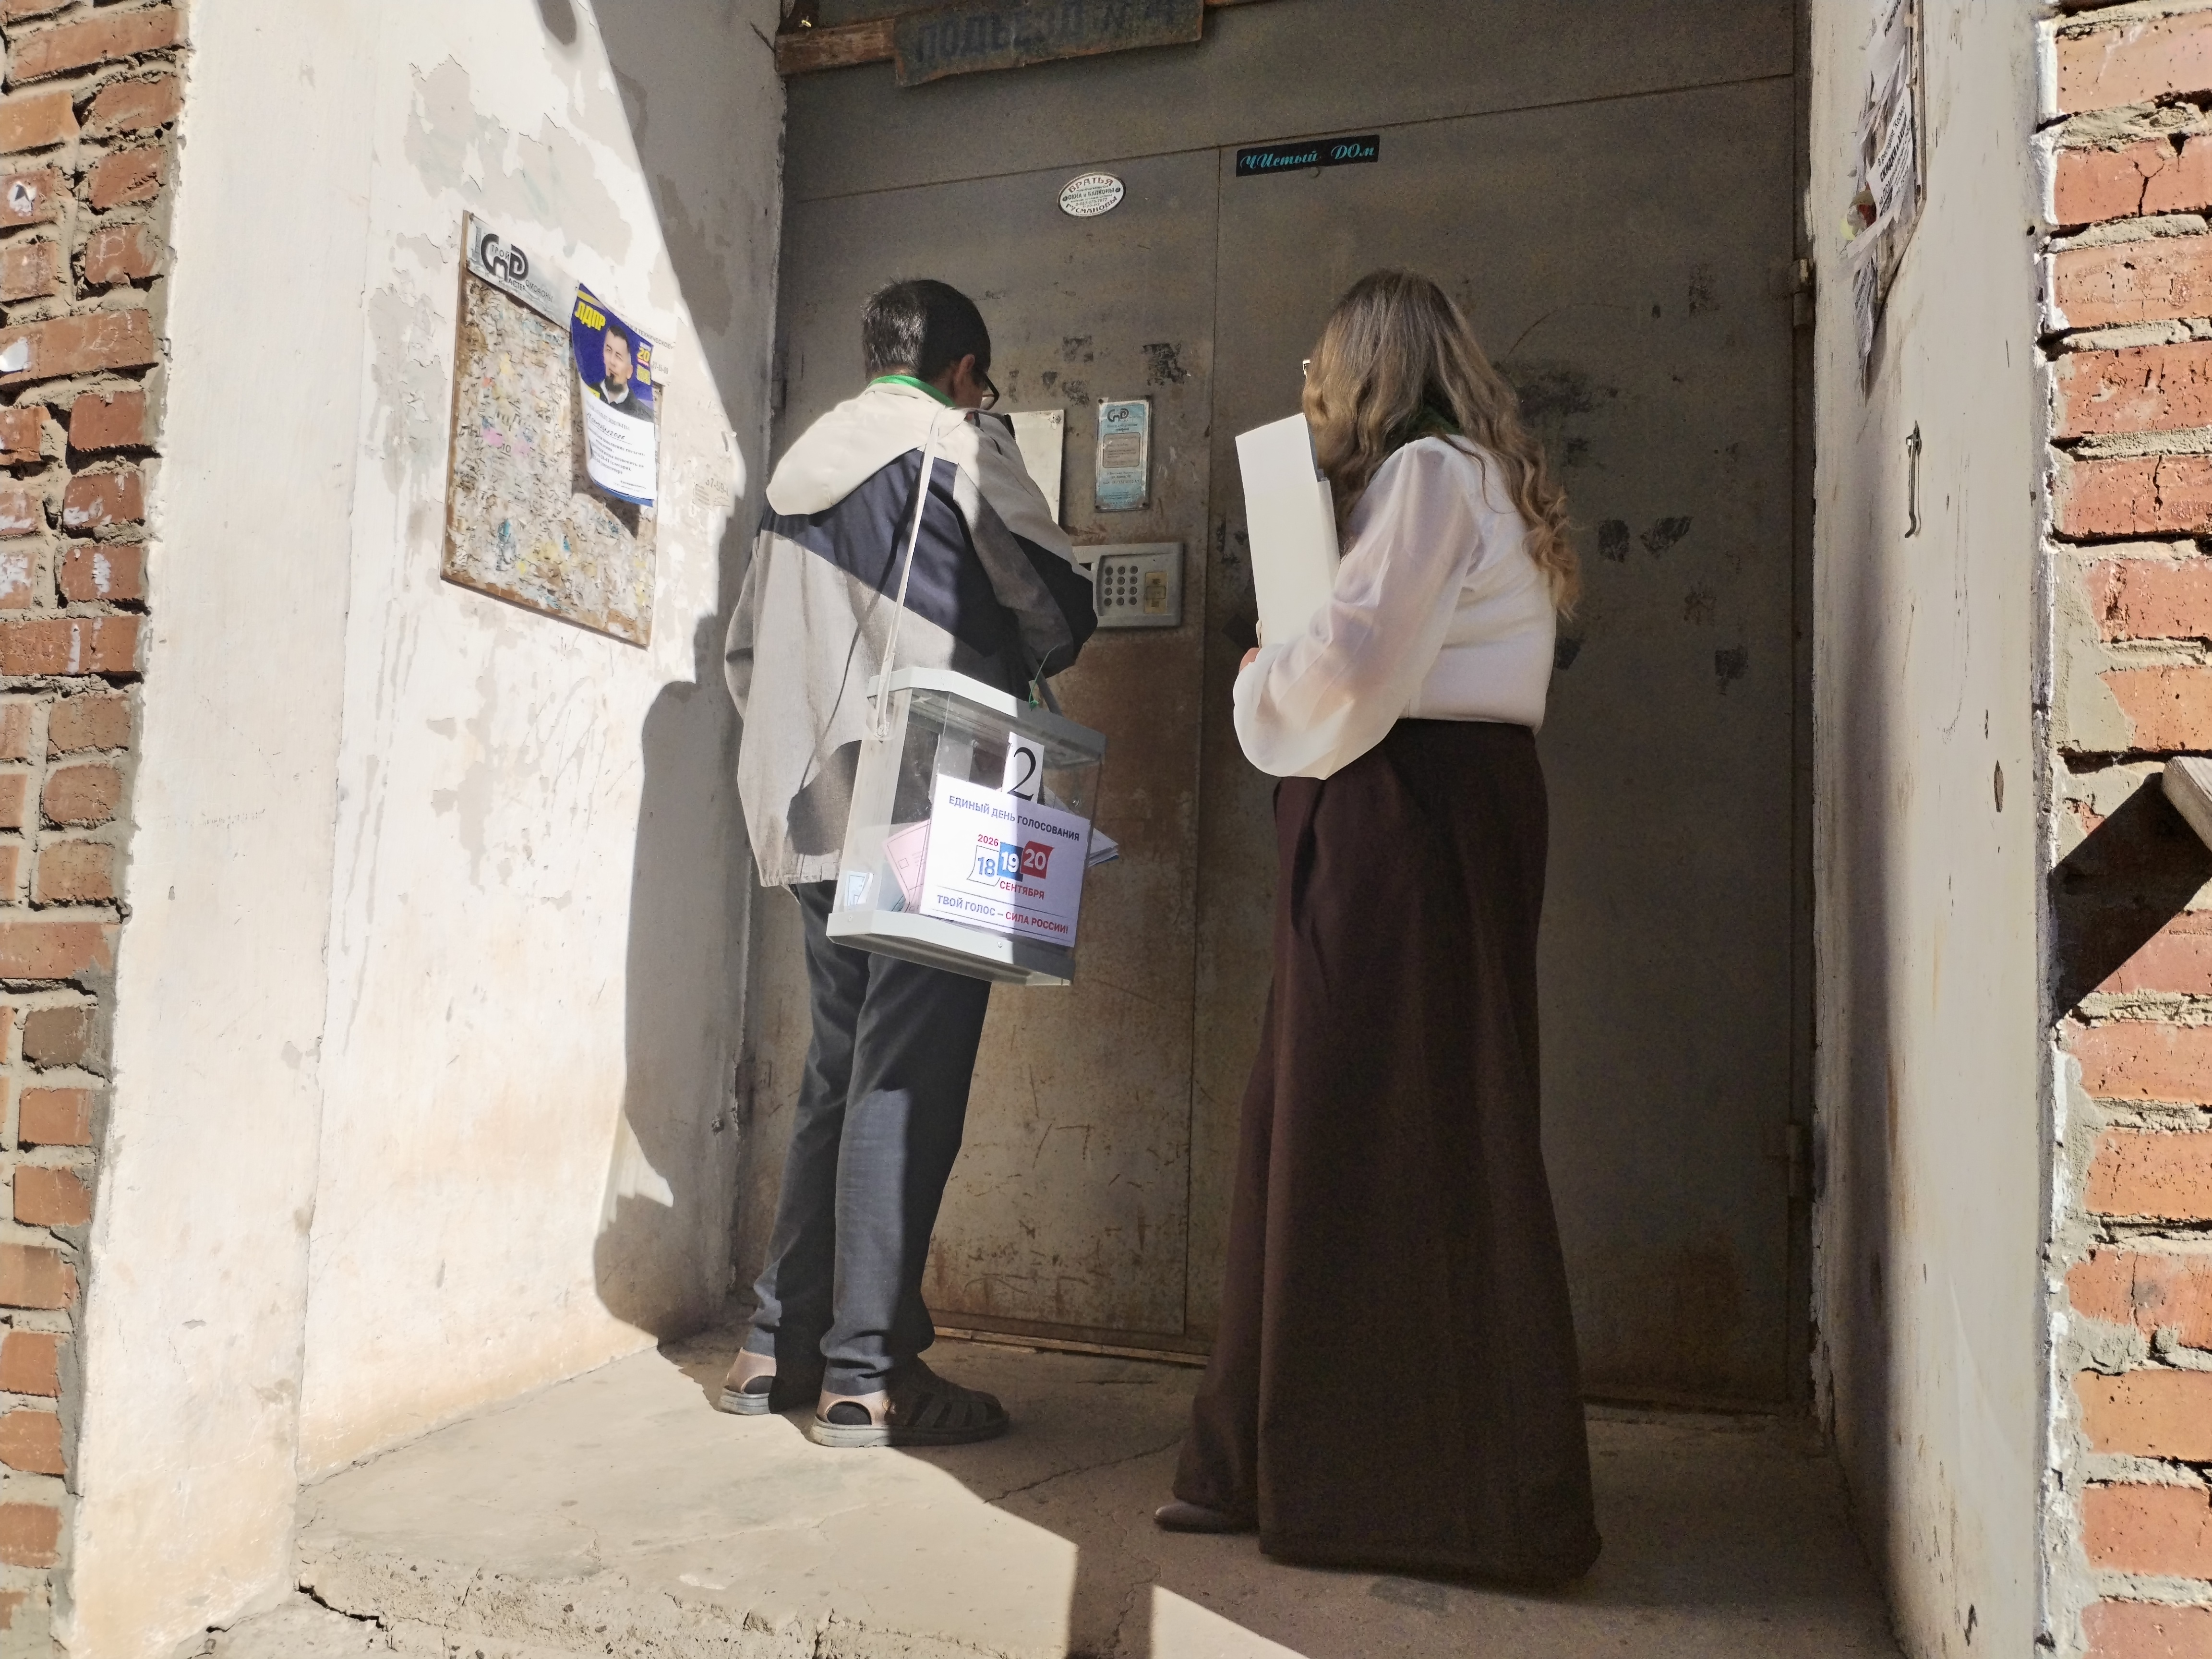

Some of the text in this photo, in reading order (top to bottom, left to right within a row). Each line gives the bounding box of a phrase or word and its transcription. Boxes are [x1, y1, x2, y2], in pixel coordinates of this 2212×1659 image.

[1880, 145, 1897, 182] СКИДКИ
[1068, 177, 1114, 193] БРАТЬЯ
[1088, 187, 1114, 196] БАЛКОНЫ
[1066, 196, 1118, 214] ГУСМАНОВЫ
[575, 301, 606, 331] ЛДПР
[637, 347, 650, 362] 20
[1007, 747, 1036, 801] 2
[949, 795, 1080, 841] ЕДИНЫЙ ДЕНЬ ГОЛОСОВАНИЯ
[977, 834, 999, 847] 2026
[977, 849, 1046, 877] 18 19 20
[1000, 881, 1045, 900] СЕНТЯБРЯ
[937, 895, 963, 909] ТВОЙ
[965, 902, 996, 916] ГОЛОС
[1006, 912, 1030, 925] СИЛА
[1031, 918, 1069, 934] РОССИИ!
